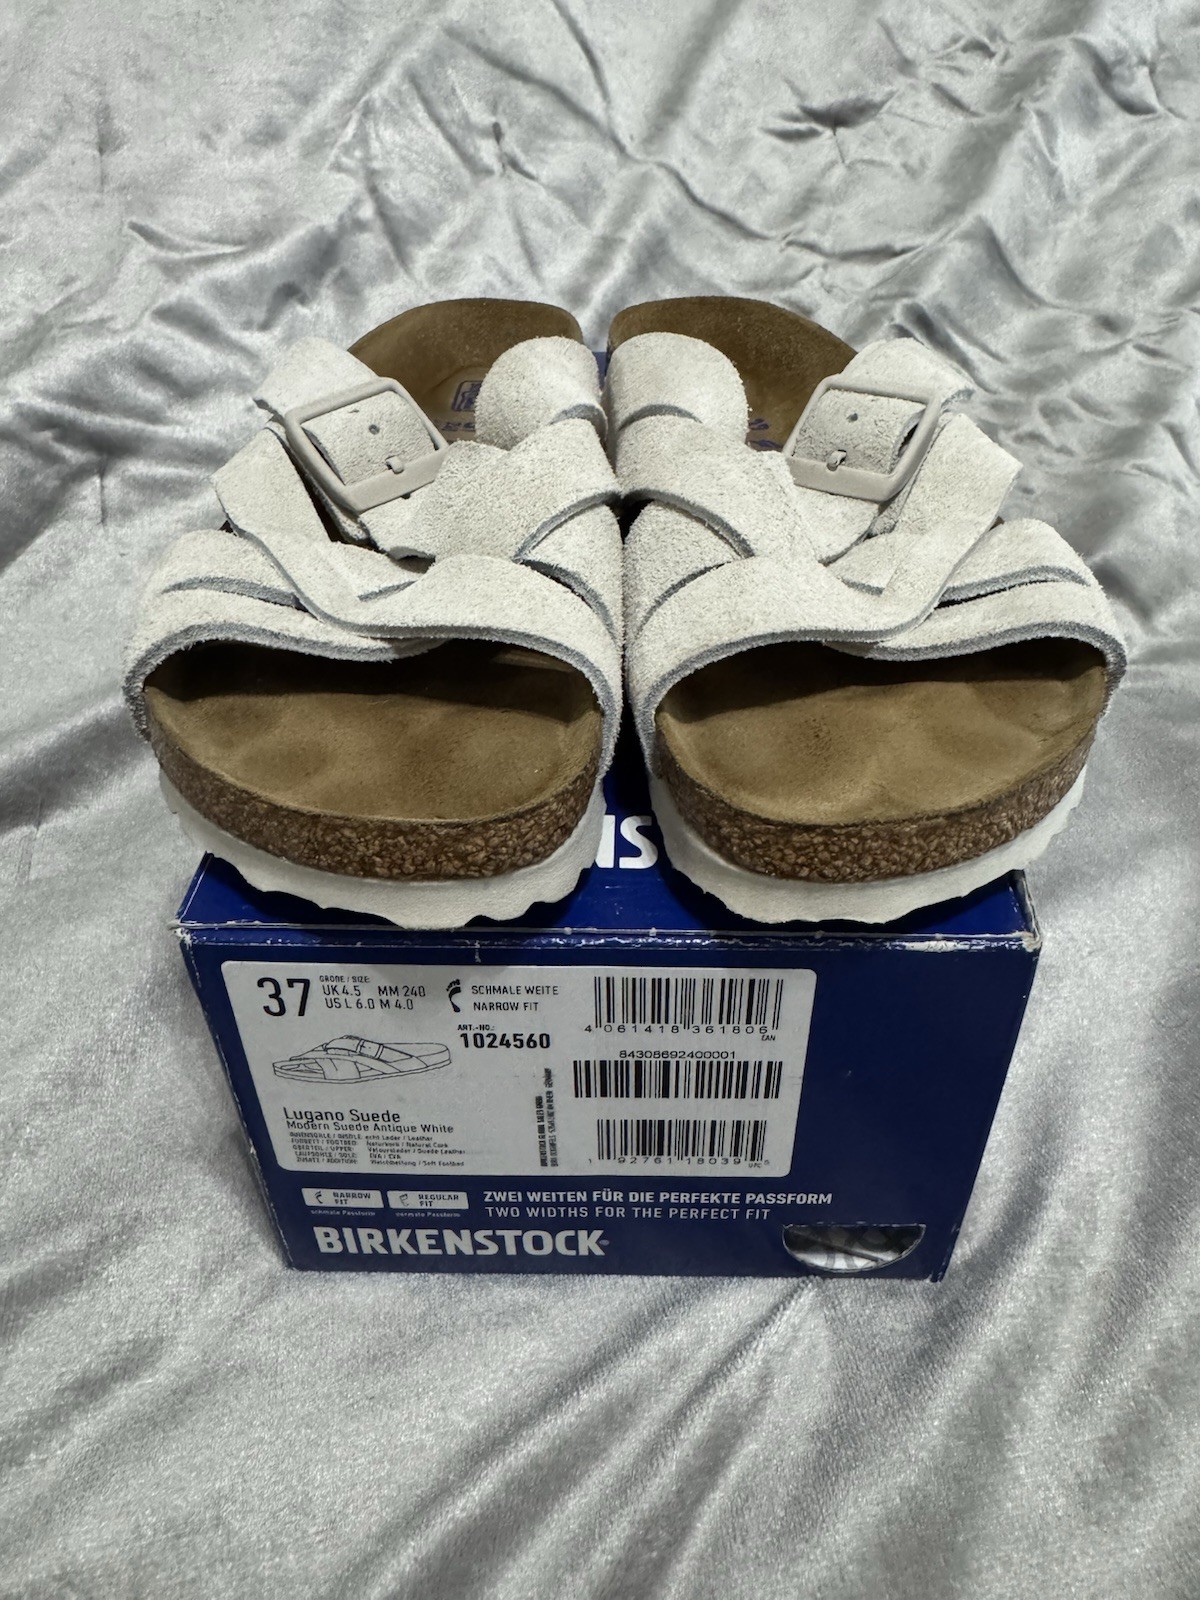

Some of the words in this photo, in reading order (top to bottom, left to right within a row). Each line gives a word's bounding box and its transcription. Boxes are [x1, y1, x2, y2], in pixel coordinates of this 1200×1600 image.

[322, 985, 339, 996] UK
[342, 985, 361, 996] 4.5
[378, 985, 400, 996] MM
[402, 986, 426, 997] 240
[471, 985, 522, 995] SCHMALE
[524, 985, 560, 995] WEITE
[256, 976, 311, 1017] 37
[325, 998, 341, 1009] US
[345, 998, 352, 1009] L
[356, 998, 375, 1009] 6.0
[380, 999, 391, 1009] M
[395, 998, 414, 1010] 4.0
[473, 1001, 520, 1011] NARROW
[523, 1002, 539, 1011] FIT
[460, 1032, 551, 1049] 1024560
[619, 1050, 736, 1060] 84308692400001
[283, 1107, 344, 1123] Lugano
[349, 1108, 400, 1122] Suede
[286, 1120, 330, 1130] Modern
[333, 1121, 369, 1131] Suede
[373, 1123, 417, 1133] Antique
[420, 1124, 454, 1133] White
[332, 1191, 371, 1199] NARROW
[418, 1193, 460, 1201] REGULAR
[483, 1191, 523, 1203] ZWEI
[527, 1191, 587, 1203] WEITEN
[593, 1188, 624, 1203] FÜR
[629, 1191, 655, 1203] DIE
[659, 1191, 741, 1204] PERFEKTE
[745, 1192, 833, 1205] PASSFORM
[485, 1206, 520, 1218] TWO
[526, 1206, 589, 1218] WIDTHS
[595, 1206, 626, 1218] FOR
[632, 1207, 662, 1219] THE
[669, 1207, 740, 1220] PERFECT
[746, 1208, 771, 1220] FIT
[313, 1226, 605, 1256] BIRKENSTOCK
